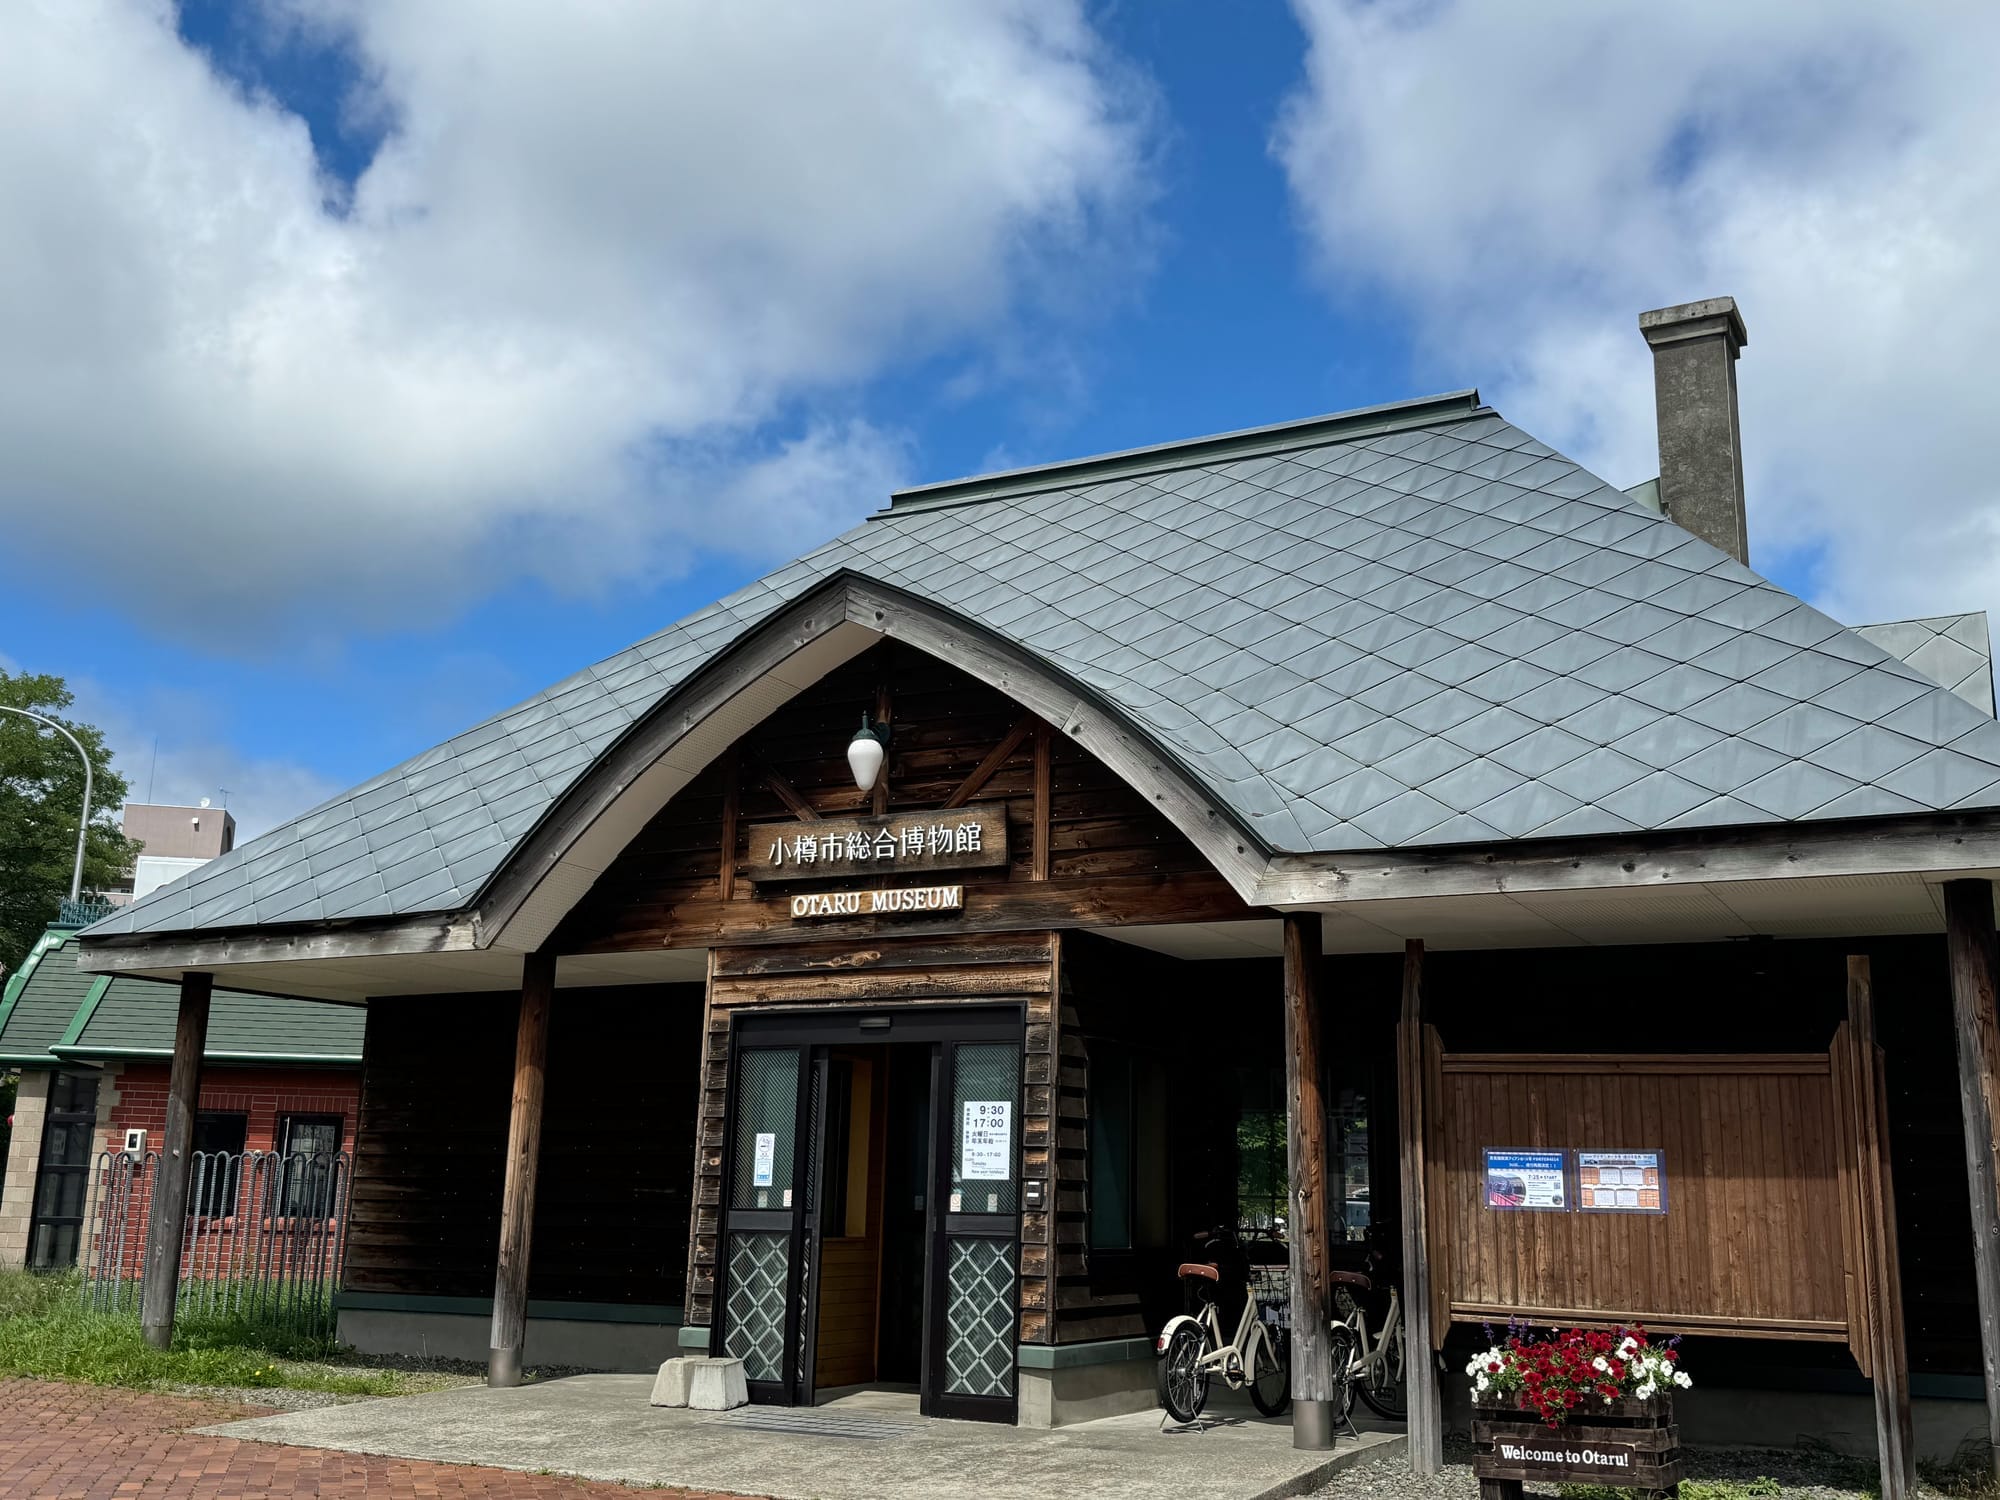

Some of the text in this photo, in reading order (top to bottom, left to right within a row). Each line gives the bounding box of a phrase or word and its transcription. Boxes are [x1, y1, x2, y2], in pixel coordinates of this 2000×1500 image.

[768, 822, 981, 865] 小樽市総合博物館
[793, 887, 959, 917] OTARU MUSEUM
[979, 1106, 1004, 1115] 9:30
[973, 1119, 1004, 1128] 17:00
[1500, 1445, 1629, 1467] Welcome to Otaru!
